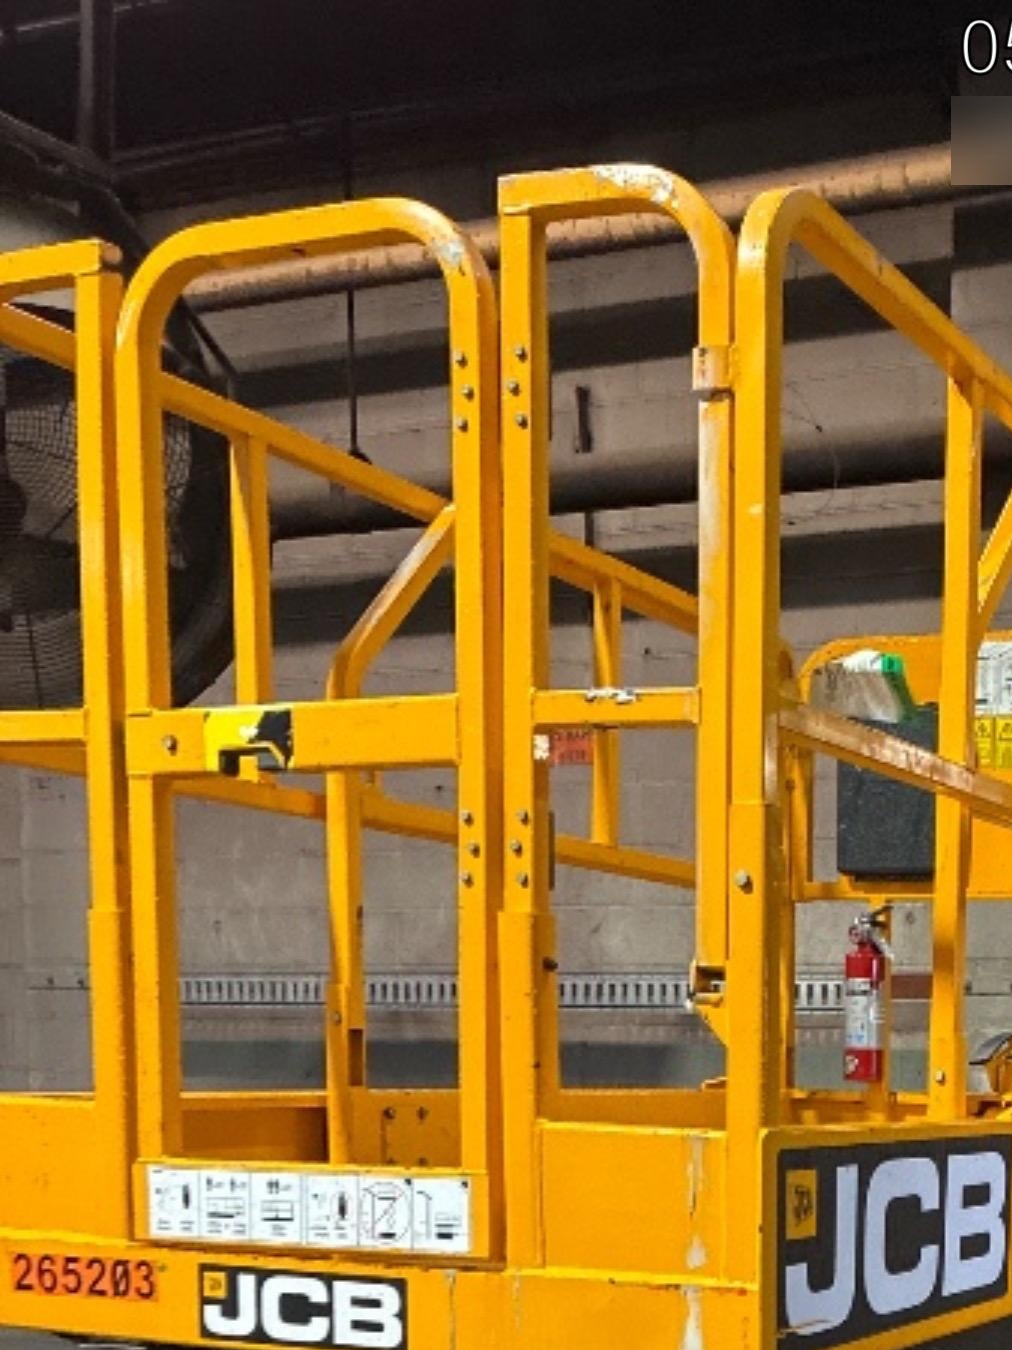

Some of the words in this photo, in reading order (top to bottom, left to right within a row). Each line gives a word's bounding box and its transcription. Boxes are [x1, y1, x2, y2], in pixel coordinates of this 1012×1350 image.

[13, 1253, 156, 1299] 265203
[785, 1151, 1006, 1336] JCB
[203, 1273, 402, 1349] JCB
